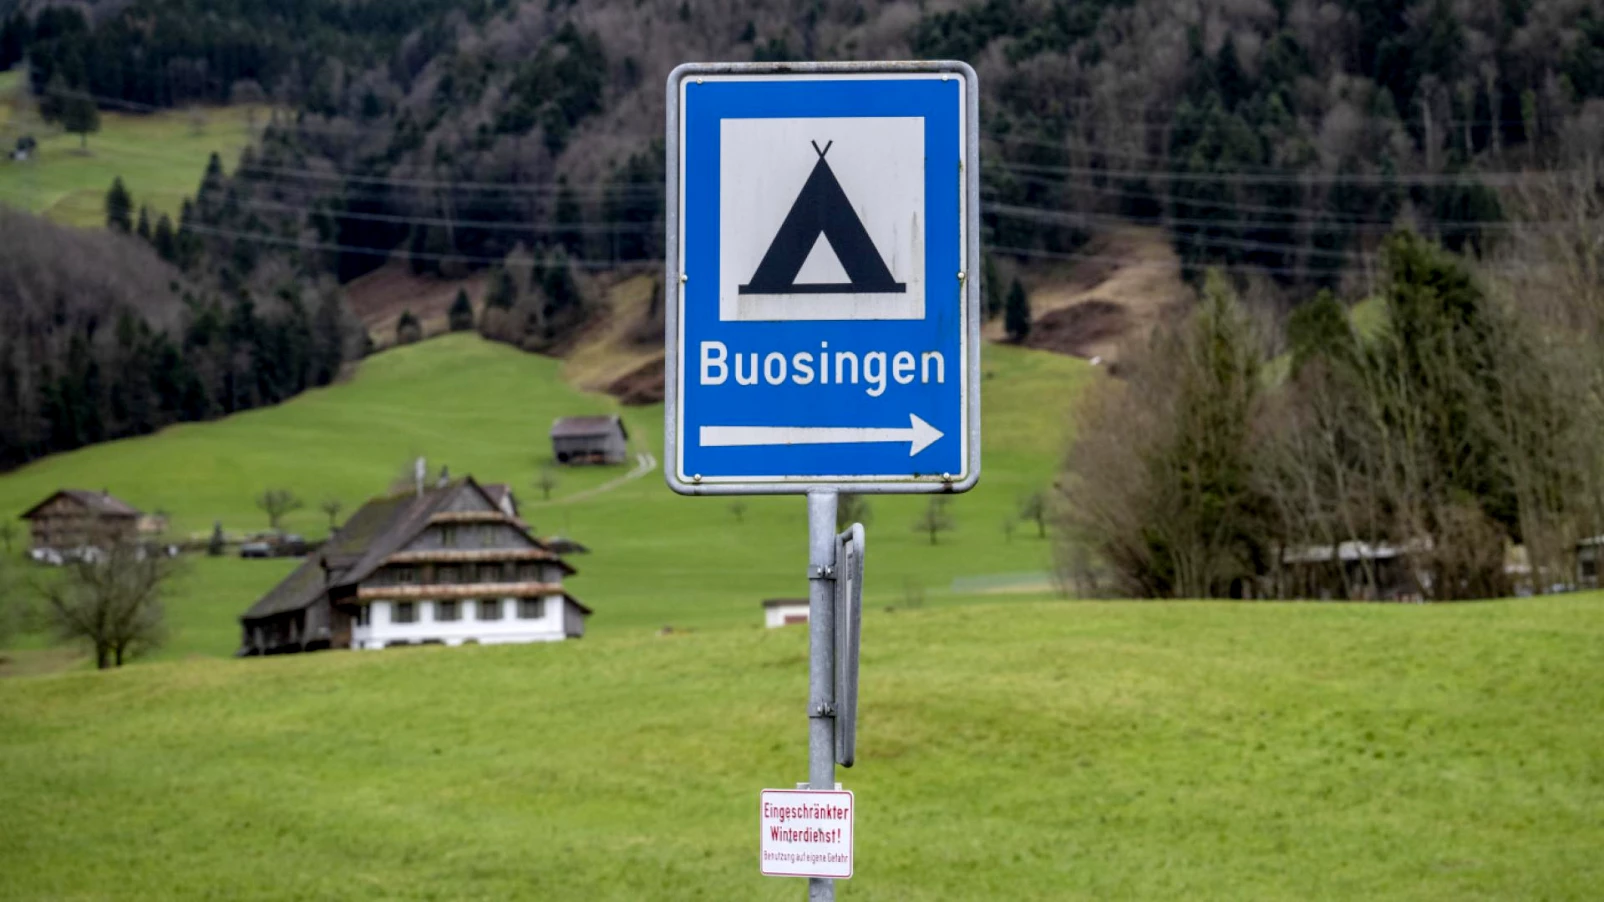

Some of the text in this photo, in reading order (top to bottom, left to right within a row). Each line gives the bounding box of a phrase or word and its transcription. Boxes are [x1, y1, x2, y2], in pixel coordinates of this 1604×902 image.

[700, 341, 945, 397] Buosingen
[764, 802, 849, 822] Eingeschränkter
[770, 826, 841, 843] Winterdienst!
[764, 850, 848, 864] Benutzung auf eigene Gefahr
